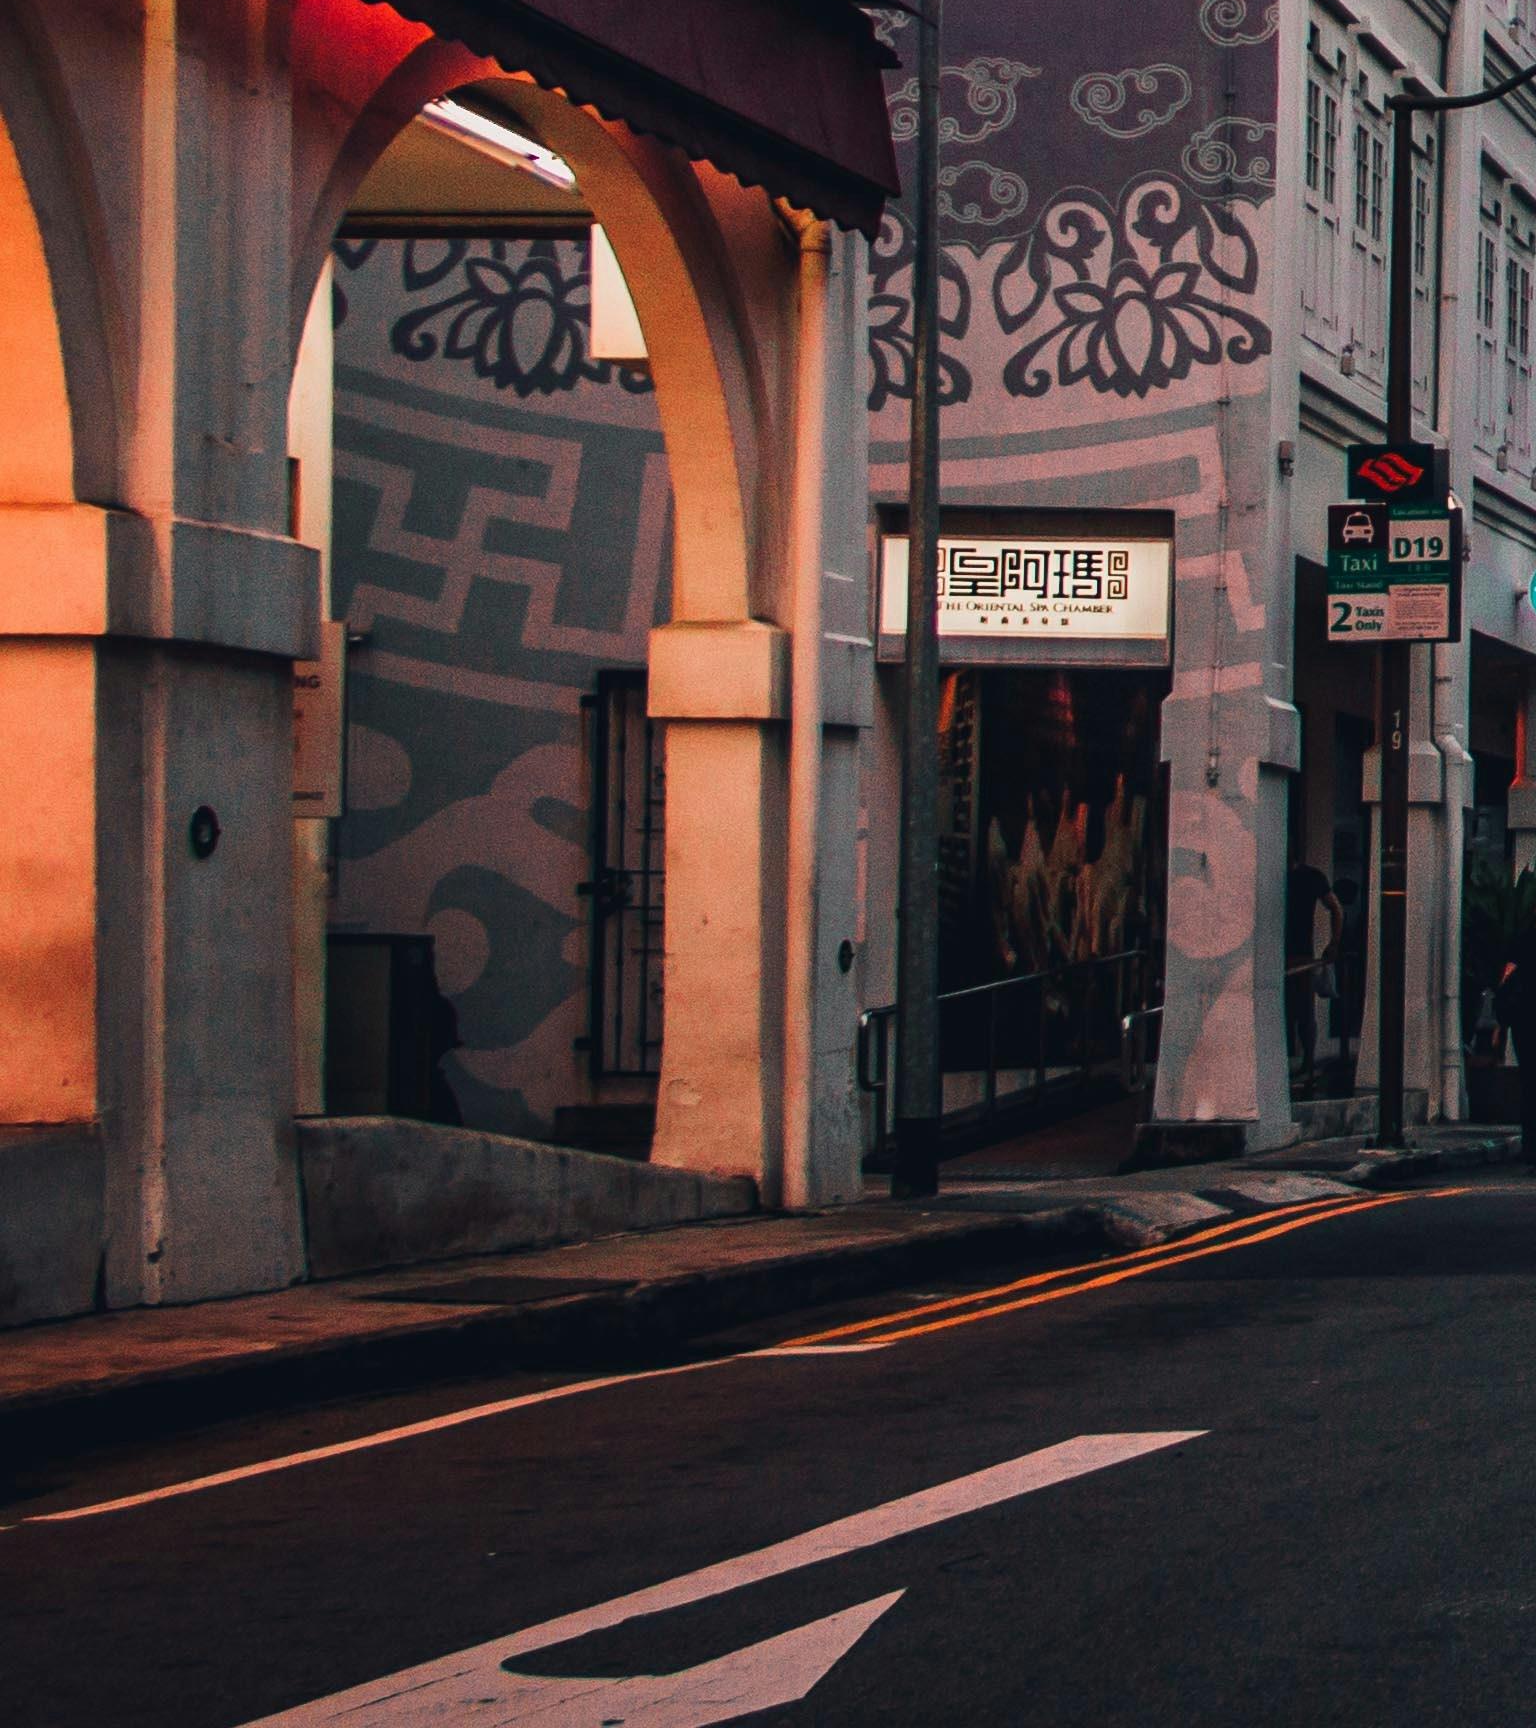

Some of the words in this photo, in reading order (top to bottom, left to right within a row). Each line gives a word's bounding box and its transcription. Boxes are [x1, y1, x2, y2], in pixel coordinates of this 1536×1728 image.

[1394, 537, 1443, 559] D19
[1339, 553, 1377, 572] Taxi
[966, 601, 1025, 612] ORIENTAL
[1030, 603, 1050, 612] SPA
[1053, 603, 1114, 614] CHAMBER
[1355, 607, 1384, 617] Taxis
[1330, 602, 1352, 633] 2
[1355, 621, 1383, 632] Only
